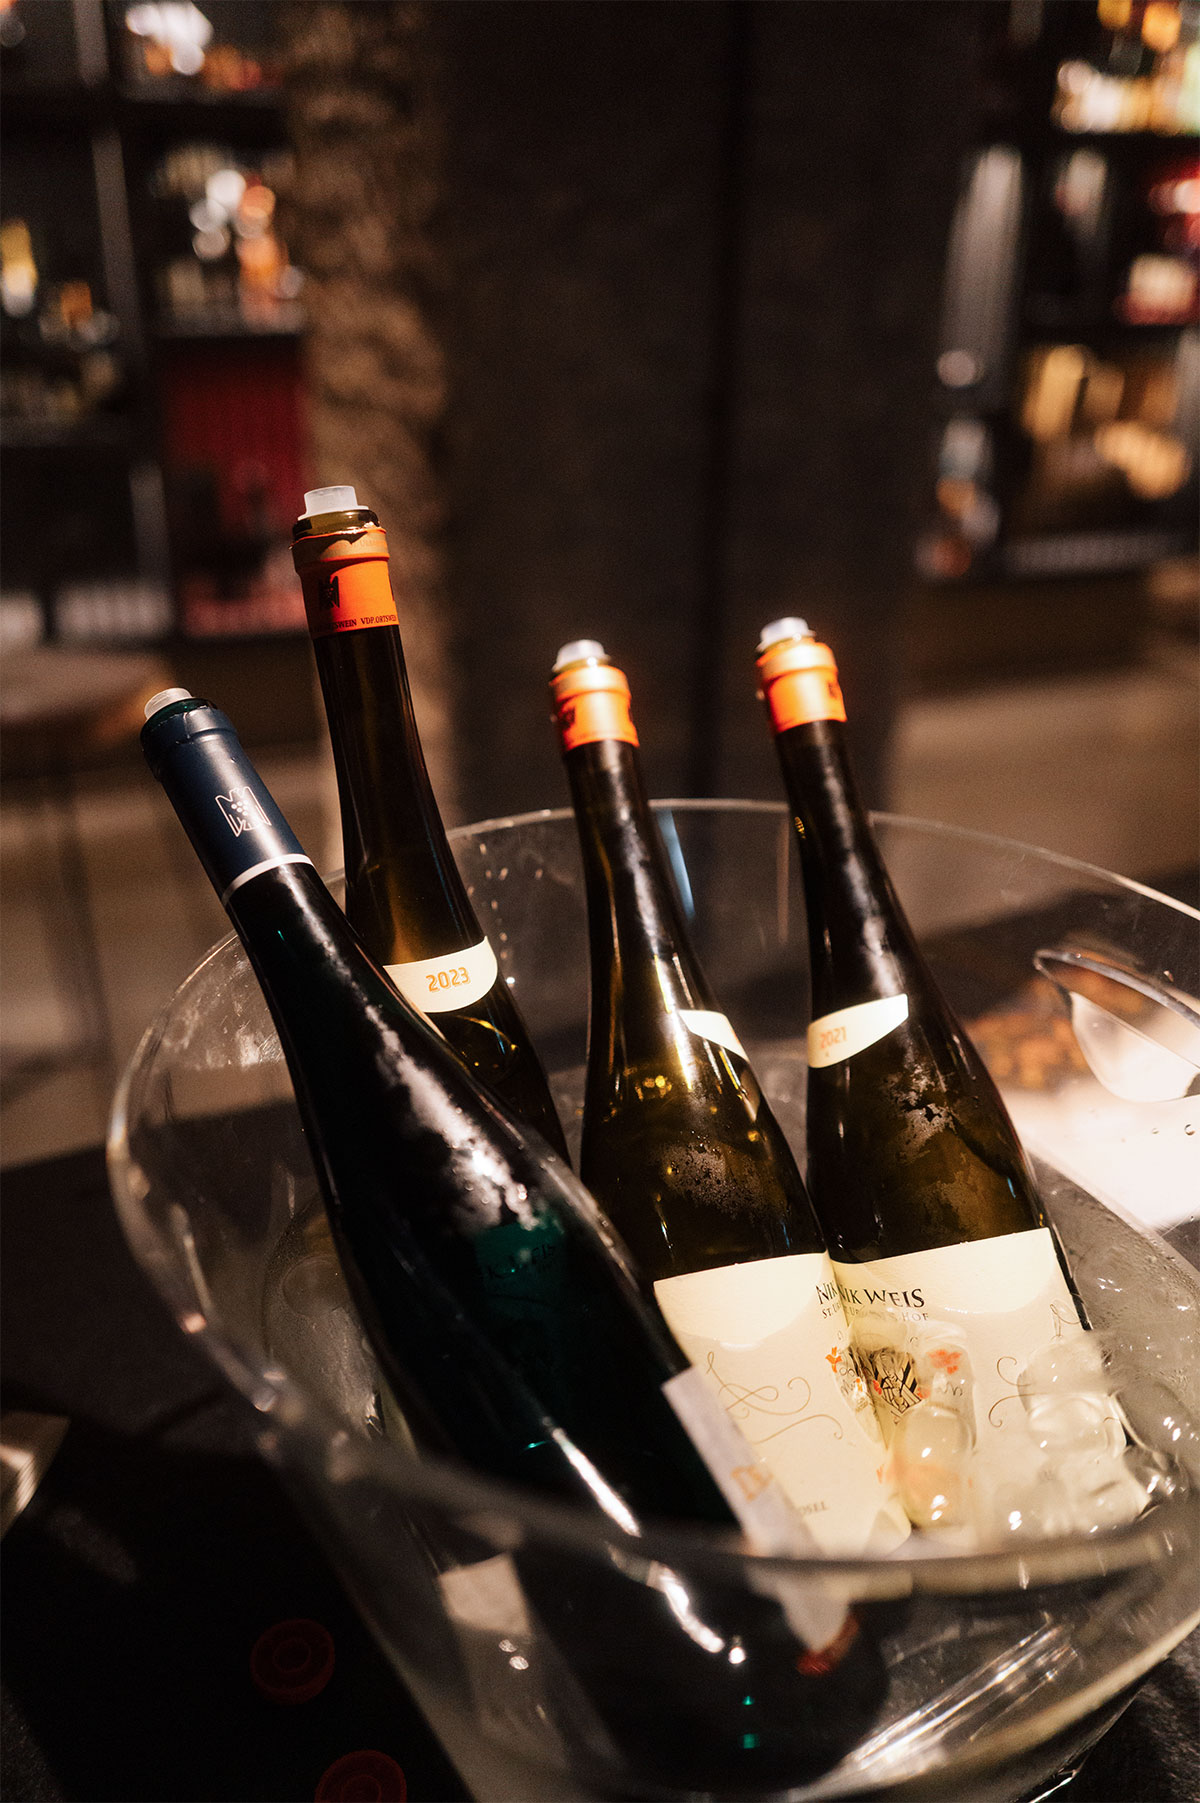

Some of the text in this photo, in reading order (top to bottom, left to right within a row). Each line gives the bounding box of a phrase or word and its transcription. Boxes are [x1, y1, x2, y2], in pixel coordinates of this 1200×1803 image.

[425, 966, 469, 993] 2023
[820, 1026, 847, 1049] 2021
[815, 1280, 838, 1305] NIK
[863, 1288, 925, 1309] WEIS
